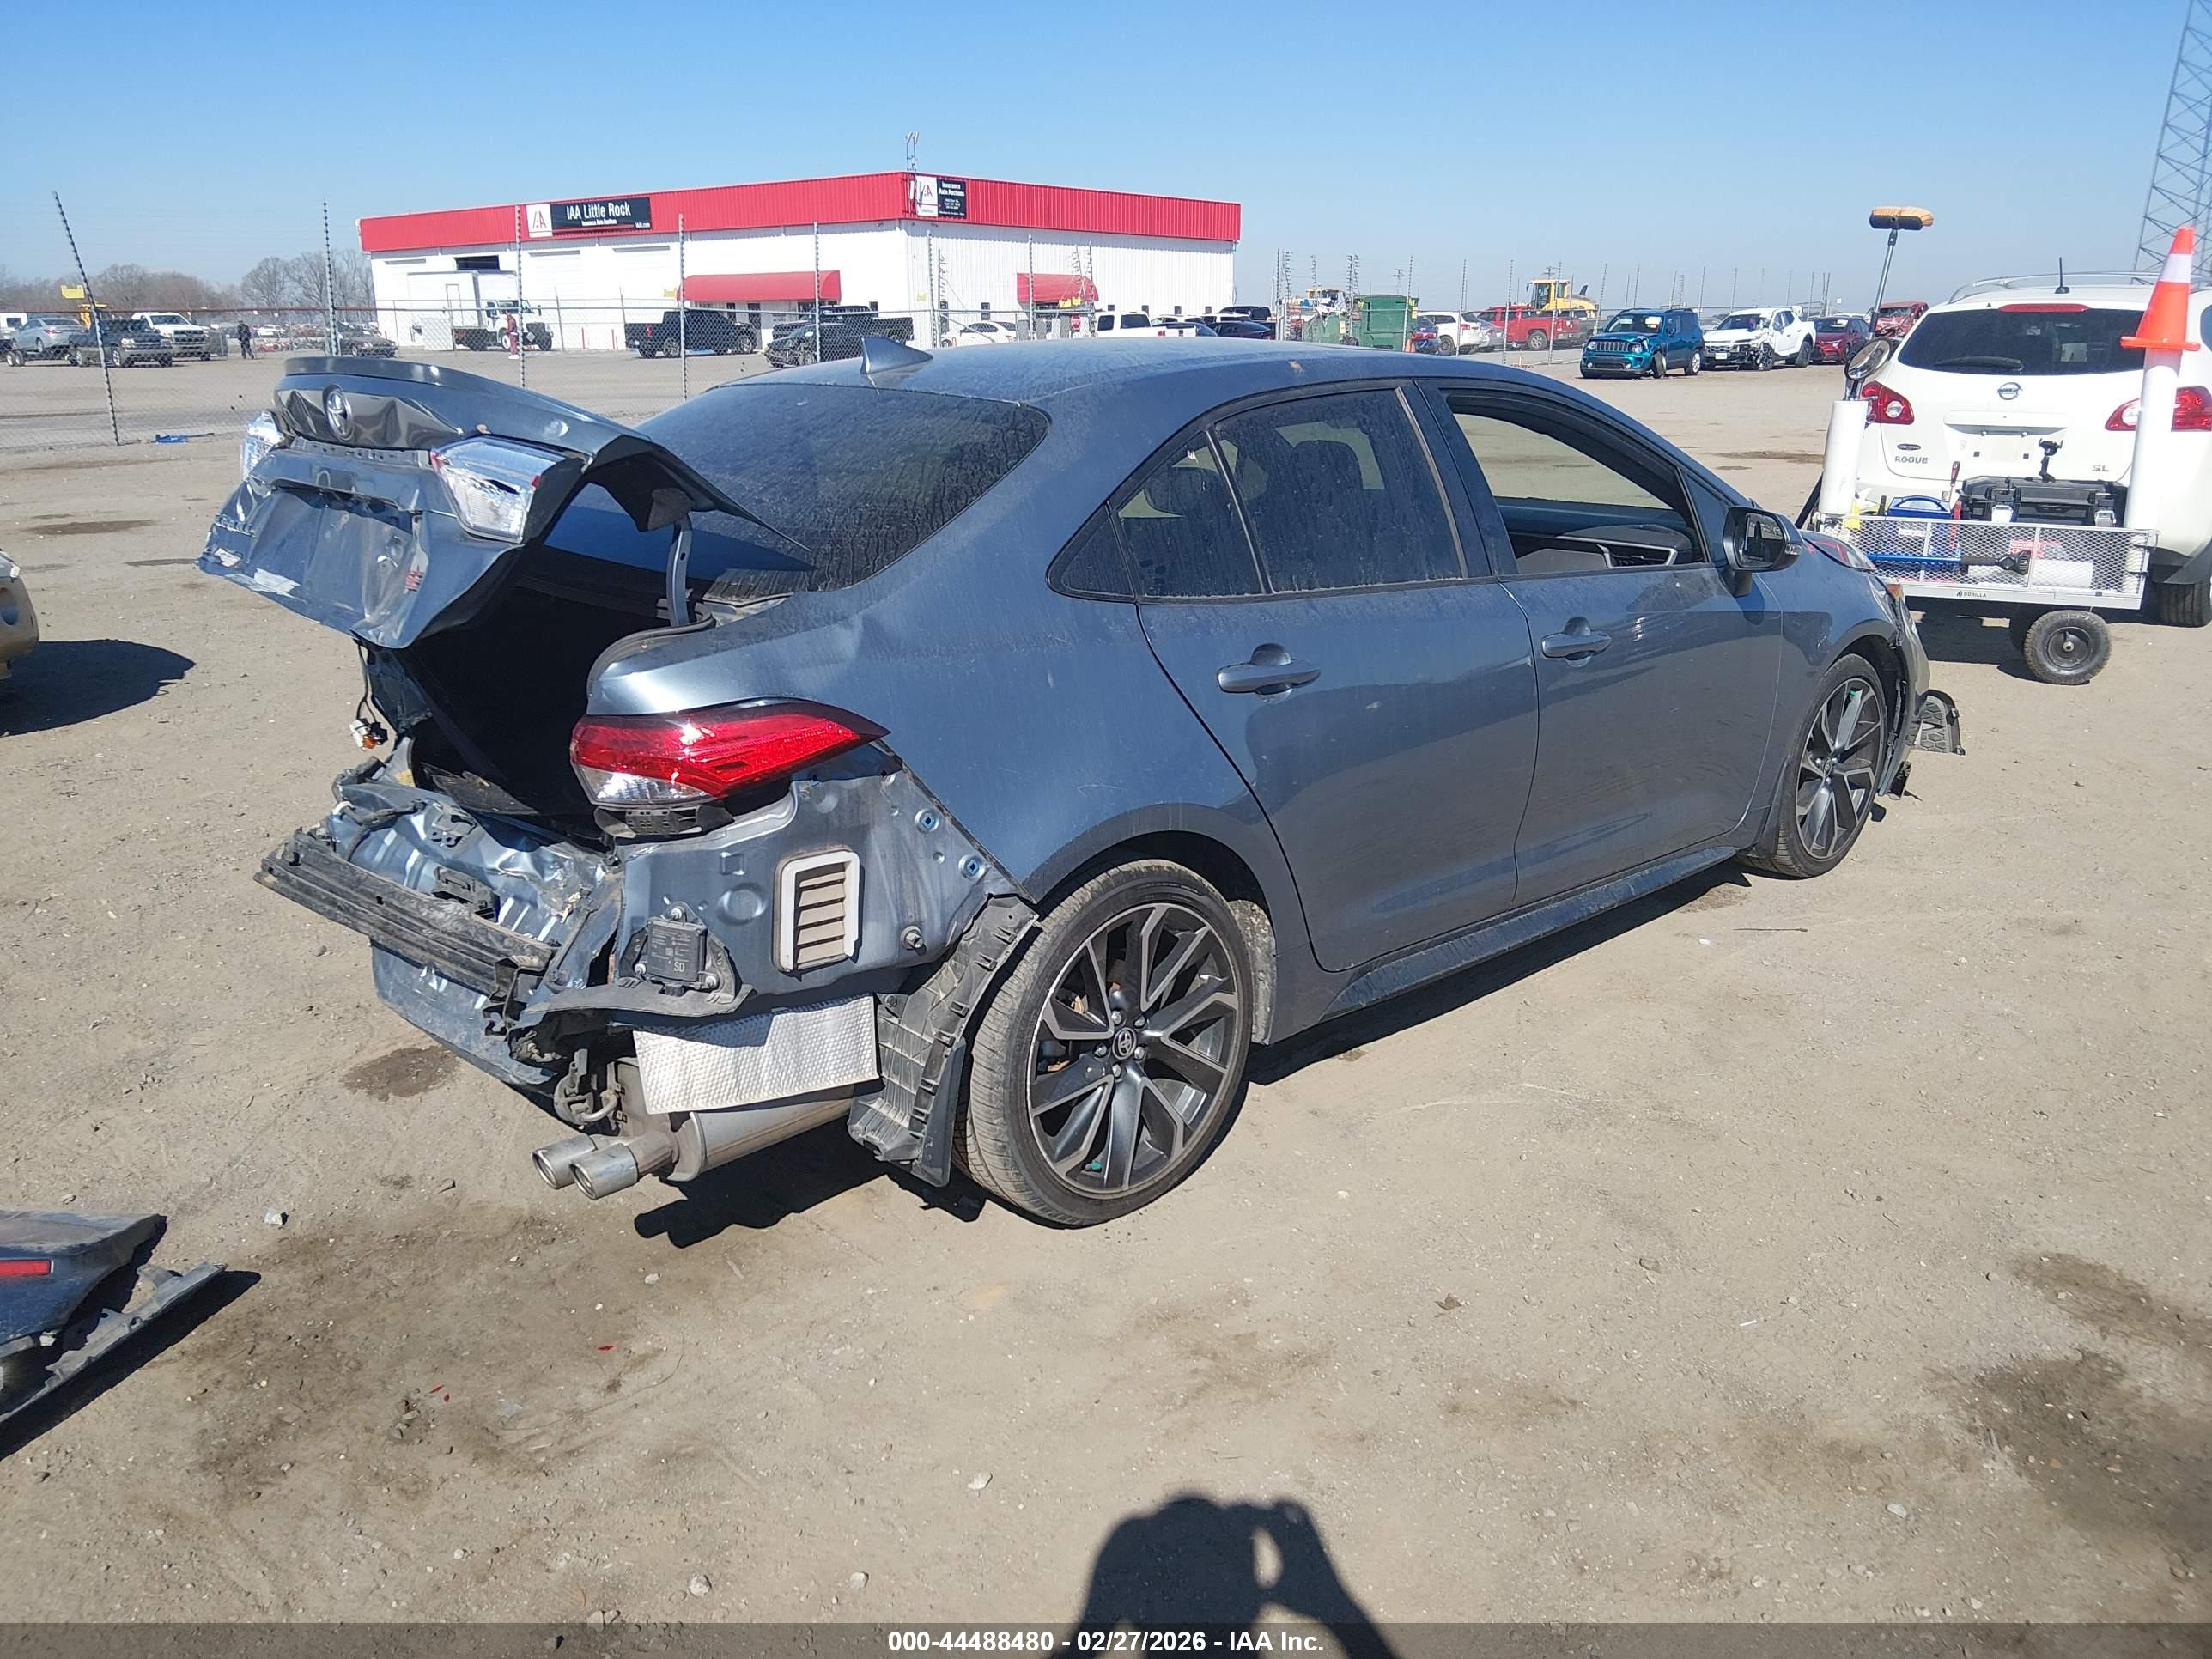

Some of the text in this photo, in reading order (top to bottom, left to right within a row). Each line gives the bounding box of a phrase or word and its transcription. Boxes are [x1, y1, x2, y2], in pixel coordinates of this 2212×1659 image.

[566, 201, 632, 220] IAA Little Rock
[1894, 455, 1929, 465] ROGUE
[673, 961, 685, 973] SD
